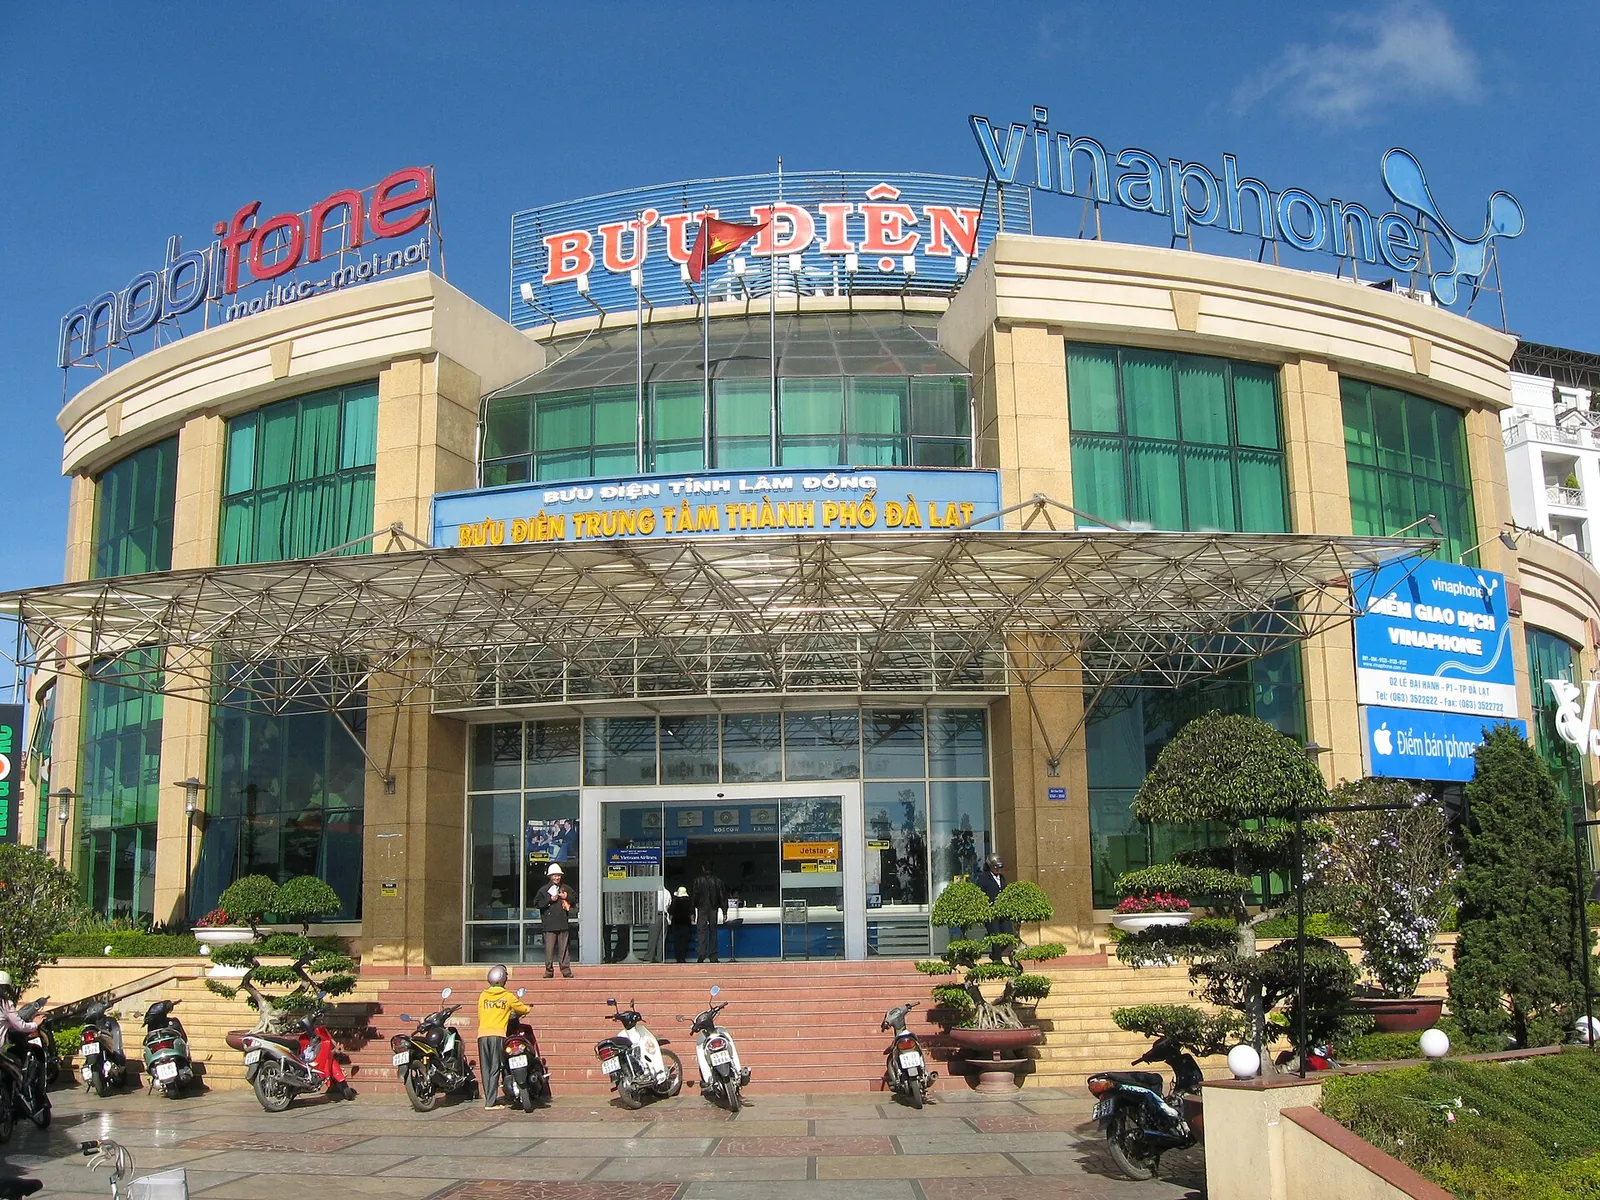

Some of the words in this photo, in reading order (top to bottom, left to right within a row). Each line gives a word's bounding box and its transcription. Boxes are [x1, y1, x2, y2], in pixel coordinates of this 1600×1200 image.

[969, 105, 1421, 272] vinaphone
[750, 182, 981, 273] ĐIỆN
[57, 165, 434, 369] mobifone
[543, 487, 594, 504] BƯU
[600, 482, 660, 501] ĐIỆN
[739, 476, 793, 492] LÂM
[458, 516, 505, 546] BƯU
[572, 508, 656, 539] TRUNG
[662, 500, 720, 533] TÂM
[725, 495, 815, 530] THÀNH
[823, 490, 877, 529] PHỐ
[884, 493, 922, 528] ĐÀ
[1431, 577, 1484, 599] vinaphone
[1414, 603, 1455, 626] GIAO
[1457, 610, 1496, 633] DỊCH
[1387, 626, 1483, 656] VINAPHONE
[1389, 677, 1398, 687] 02
[1446, 683, 1453, 693] P1
[1459, 684, 1467, 694] TP
[1376, 691, 1388, 701] Tel:
[1390, 692, 1408, 704] (063)
[1459, 698, 1477, 711] (063)
[1397, 727, 1424, 756] Điểm
[1424, 732, 1444, 757] bán
